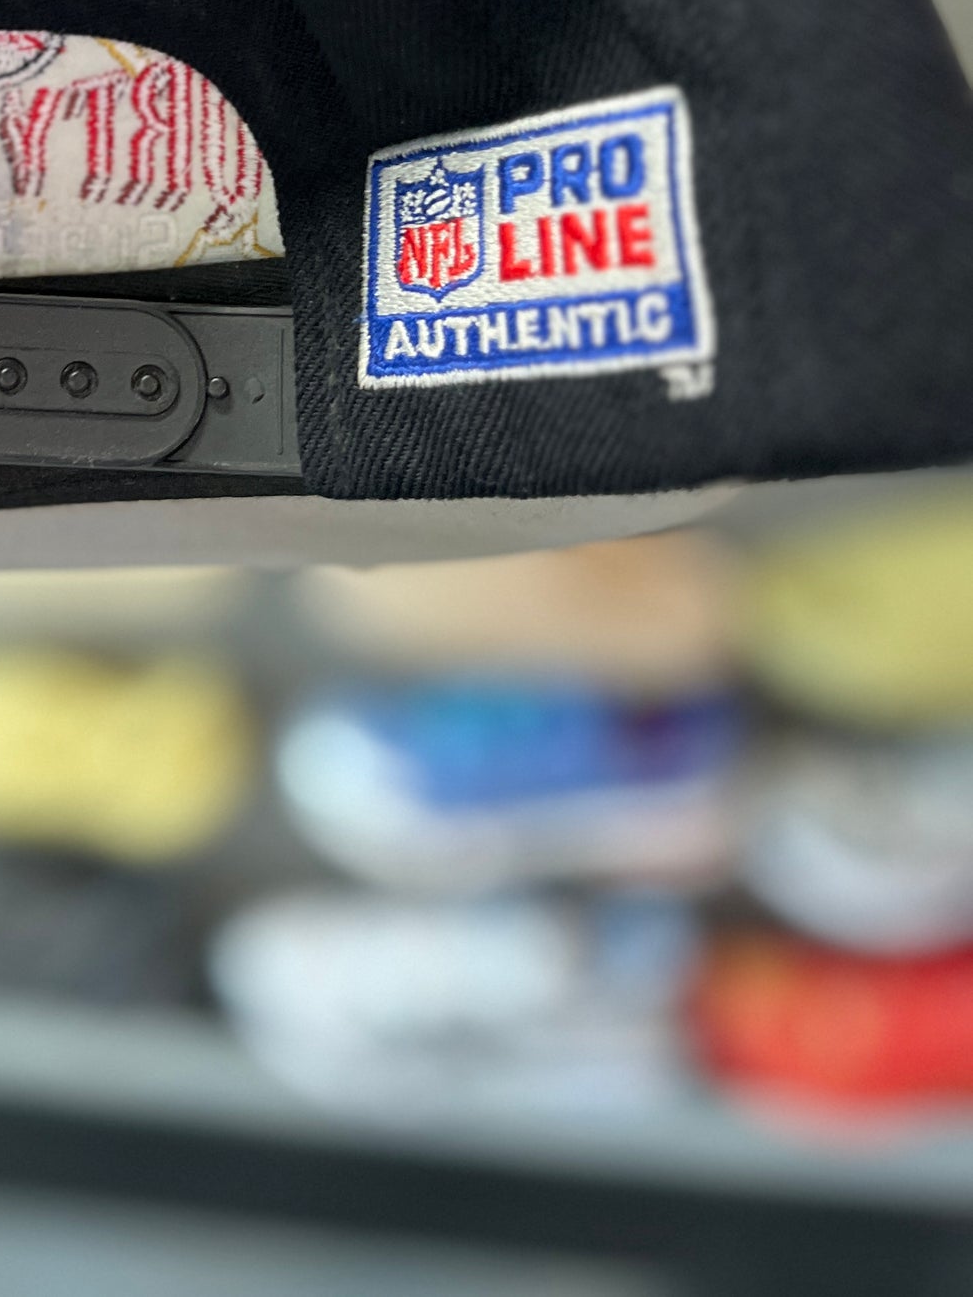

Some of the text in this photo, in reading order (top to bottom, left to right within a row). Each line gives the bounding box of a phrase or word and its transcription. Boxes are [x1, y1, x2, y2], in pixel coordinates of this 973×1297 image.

[497, 132, 645, 215] PRO
[396, 217, 476, 289] NFL
[498, 203, 656, 284] LINE
[384, 290, 675, 361] AUTHENTIC
